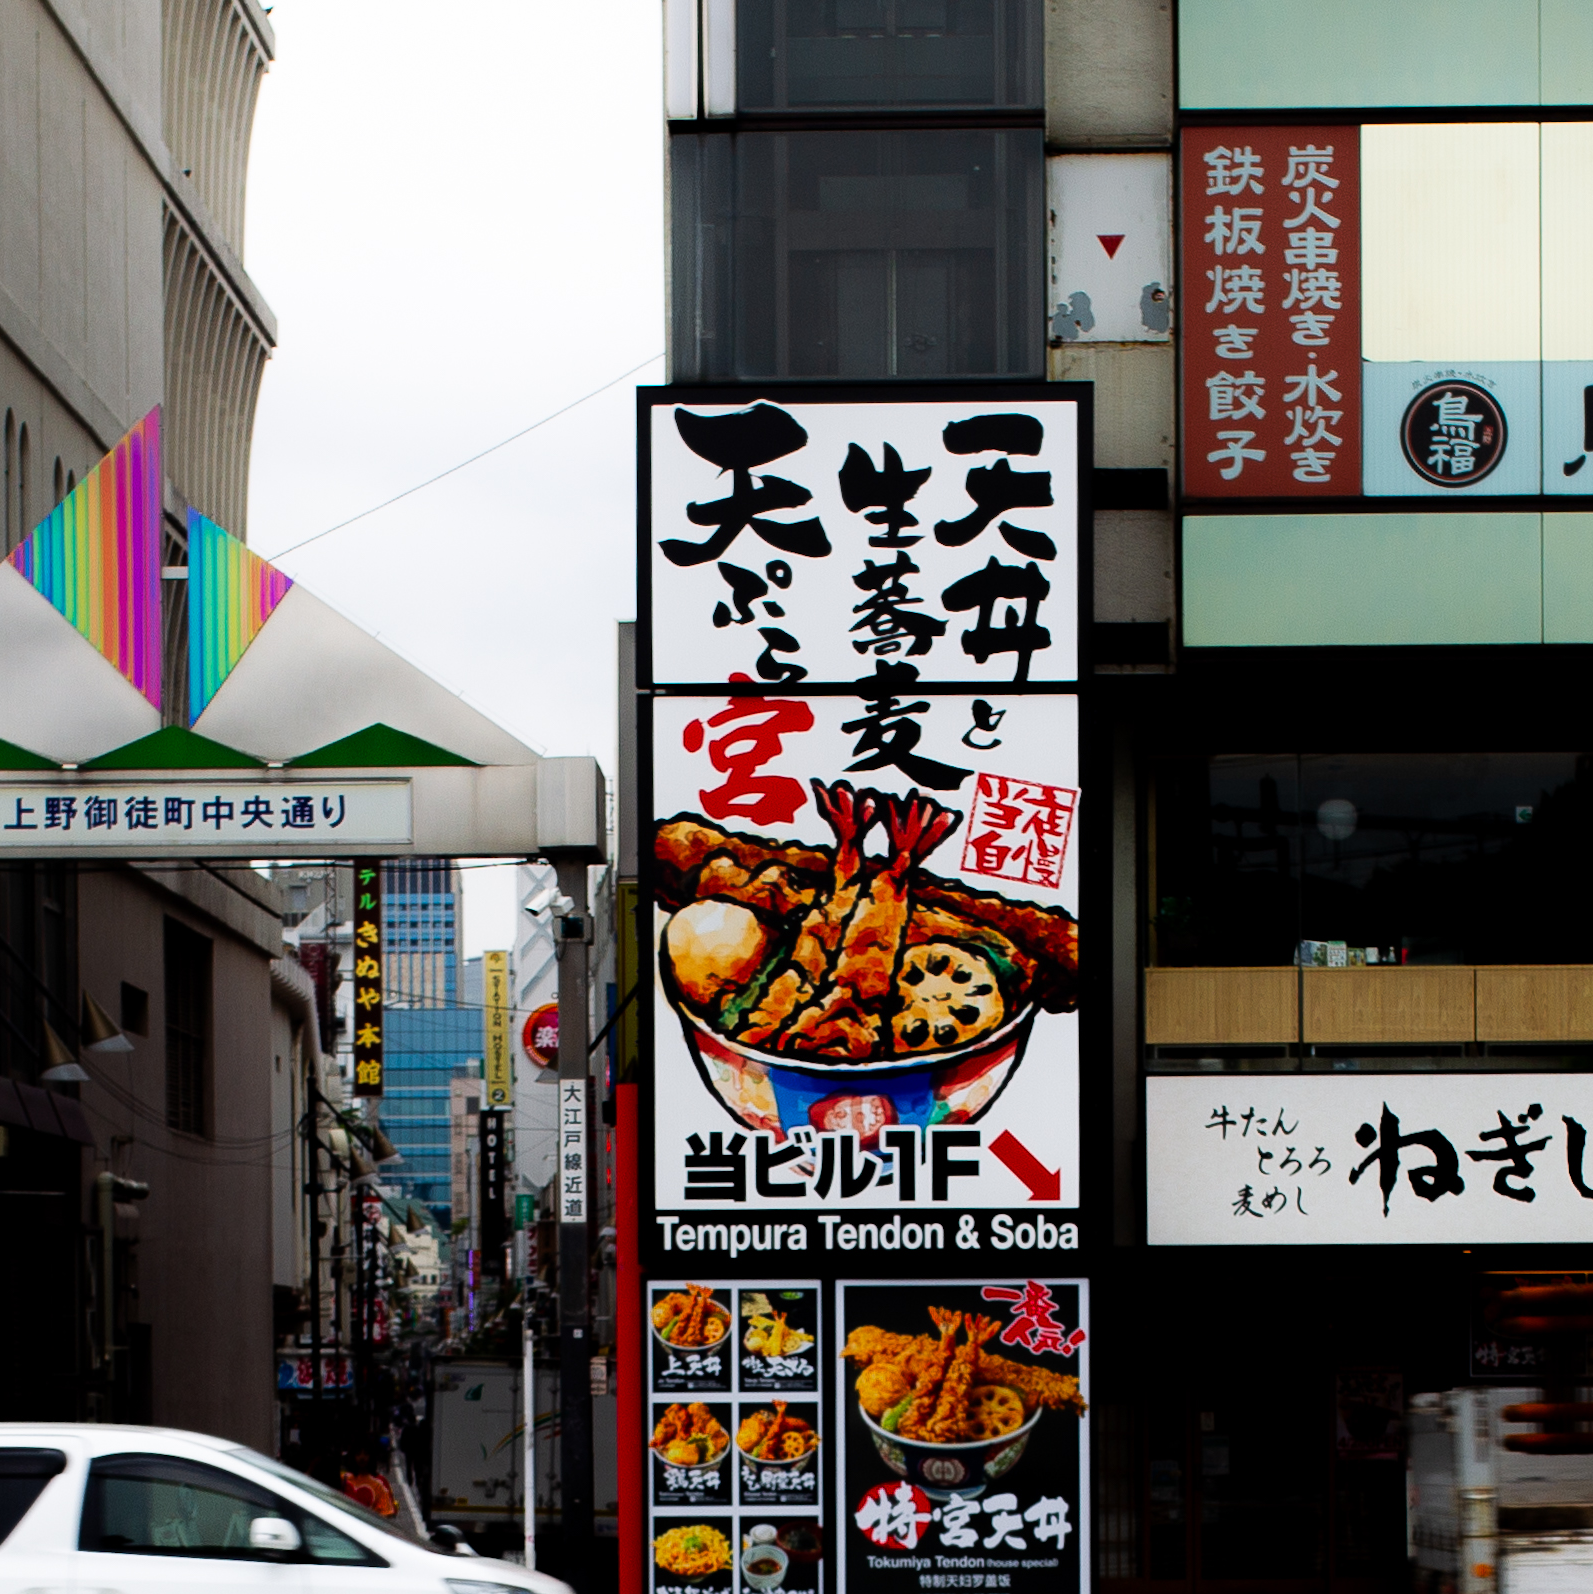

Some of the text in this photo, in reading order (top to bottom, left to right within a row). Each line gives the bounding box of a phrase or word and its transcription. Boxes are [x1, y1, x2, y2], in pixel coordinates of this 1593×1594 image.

[1203, 145, 1266, 482] 鉄板焼き餃子
[1281, 144, 1342, 483] 炭火串焼き・水炊き
[1426, 391, 1485, 475] 鳥福
[658, 399, 832, 825] 天ぷら 宮
[3, 794, 348, 832] 上野御徒町中央通り
[355, 868, 382, 1087] テルきぬや本館
[534, 1025, 559, 1049] 楽
[563, 1084, 583, 1217] 大江戸線近道
[1205, 1106, 1299, 1140] 牛たん
[486, 1117, 497, 1200] HOTEL
[684, 1129, 982, 1203] 当ビル1F
[1257, 1144, 1333, 1177] とろろ
[1231, 1184, 1310, 1219] 麦めし
[655, 1213, 1080, 1258] Tempura Tendon & Soba
[661, 1353, 723, 1377] 上天丼
[866, 1555, 932, 1571] Tokumiya
[934, 1554, 986, 1569] Tendon
